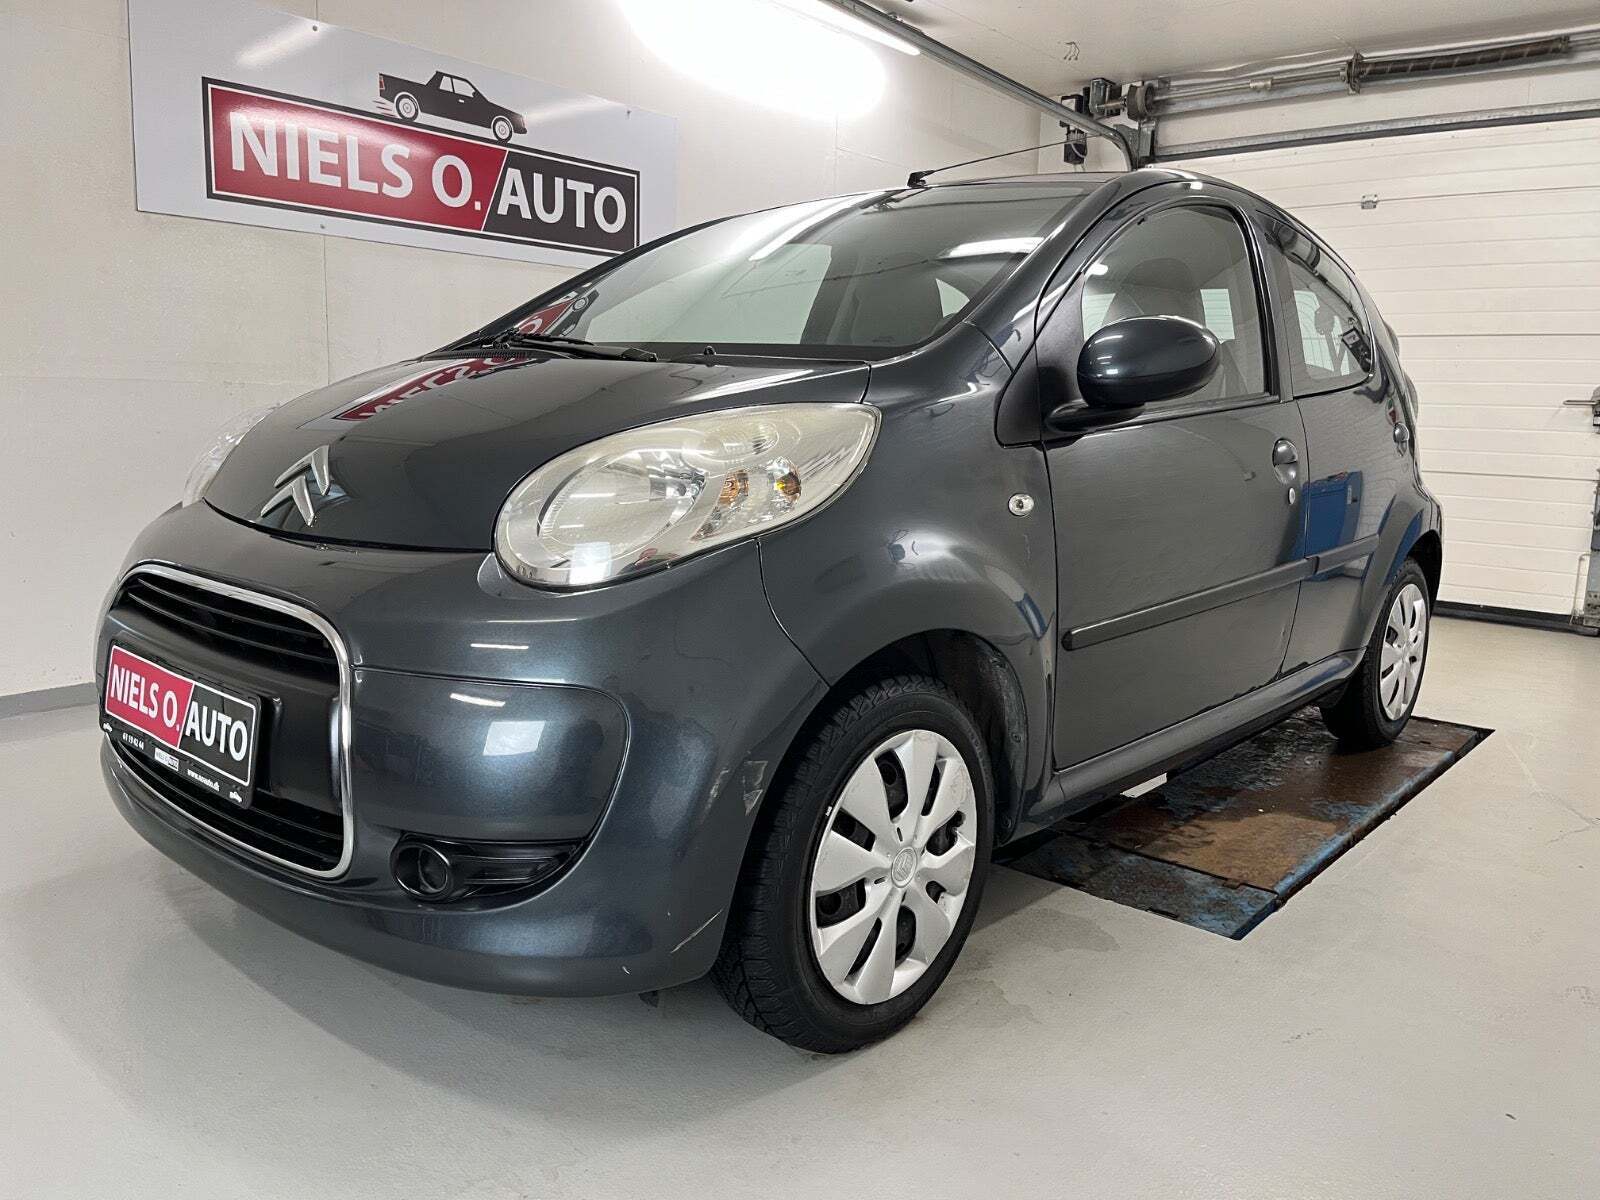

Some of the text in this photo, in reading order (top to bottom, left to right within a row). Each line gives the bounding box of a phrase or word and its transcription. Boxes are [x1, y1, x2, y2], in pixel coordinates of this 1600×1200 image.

[231, 113, 626, 234] NIELS O. AUTO
[110, 664, 159, 718] NIELS
[163, 691, 179, 731] O.
[185, 701, 248, 761] AUTO
